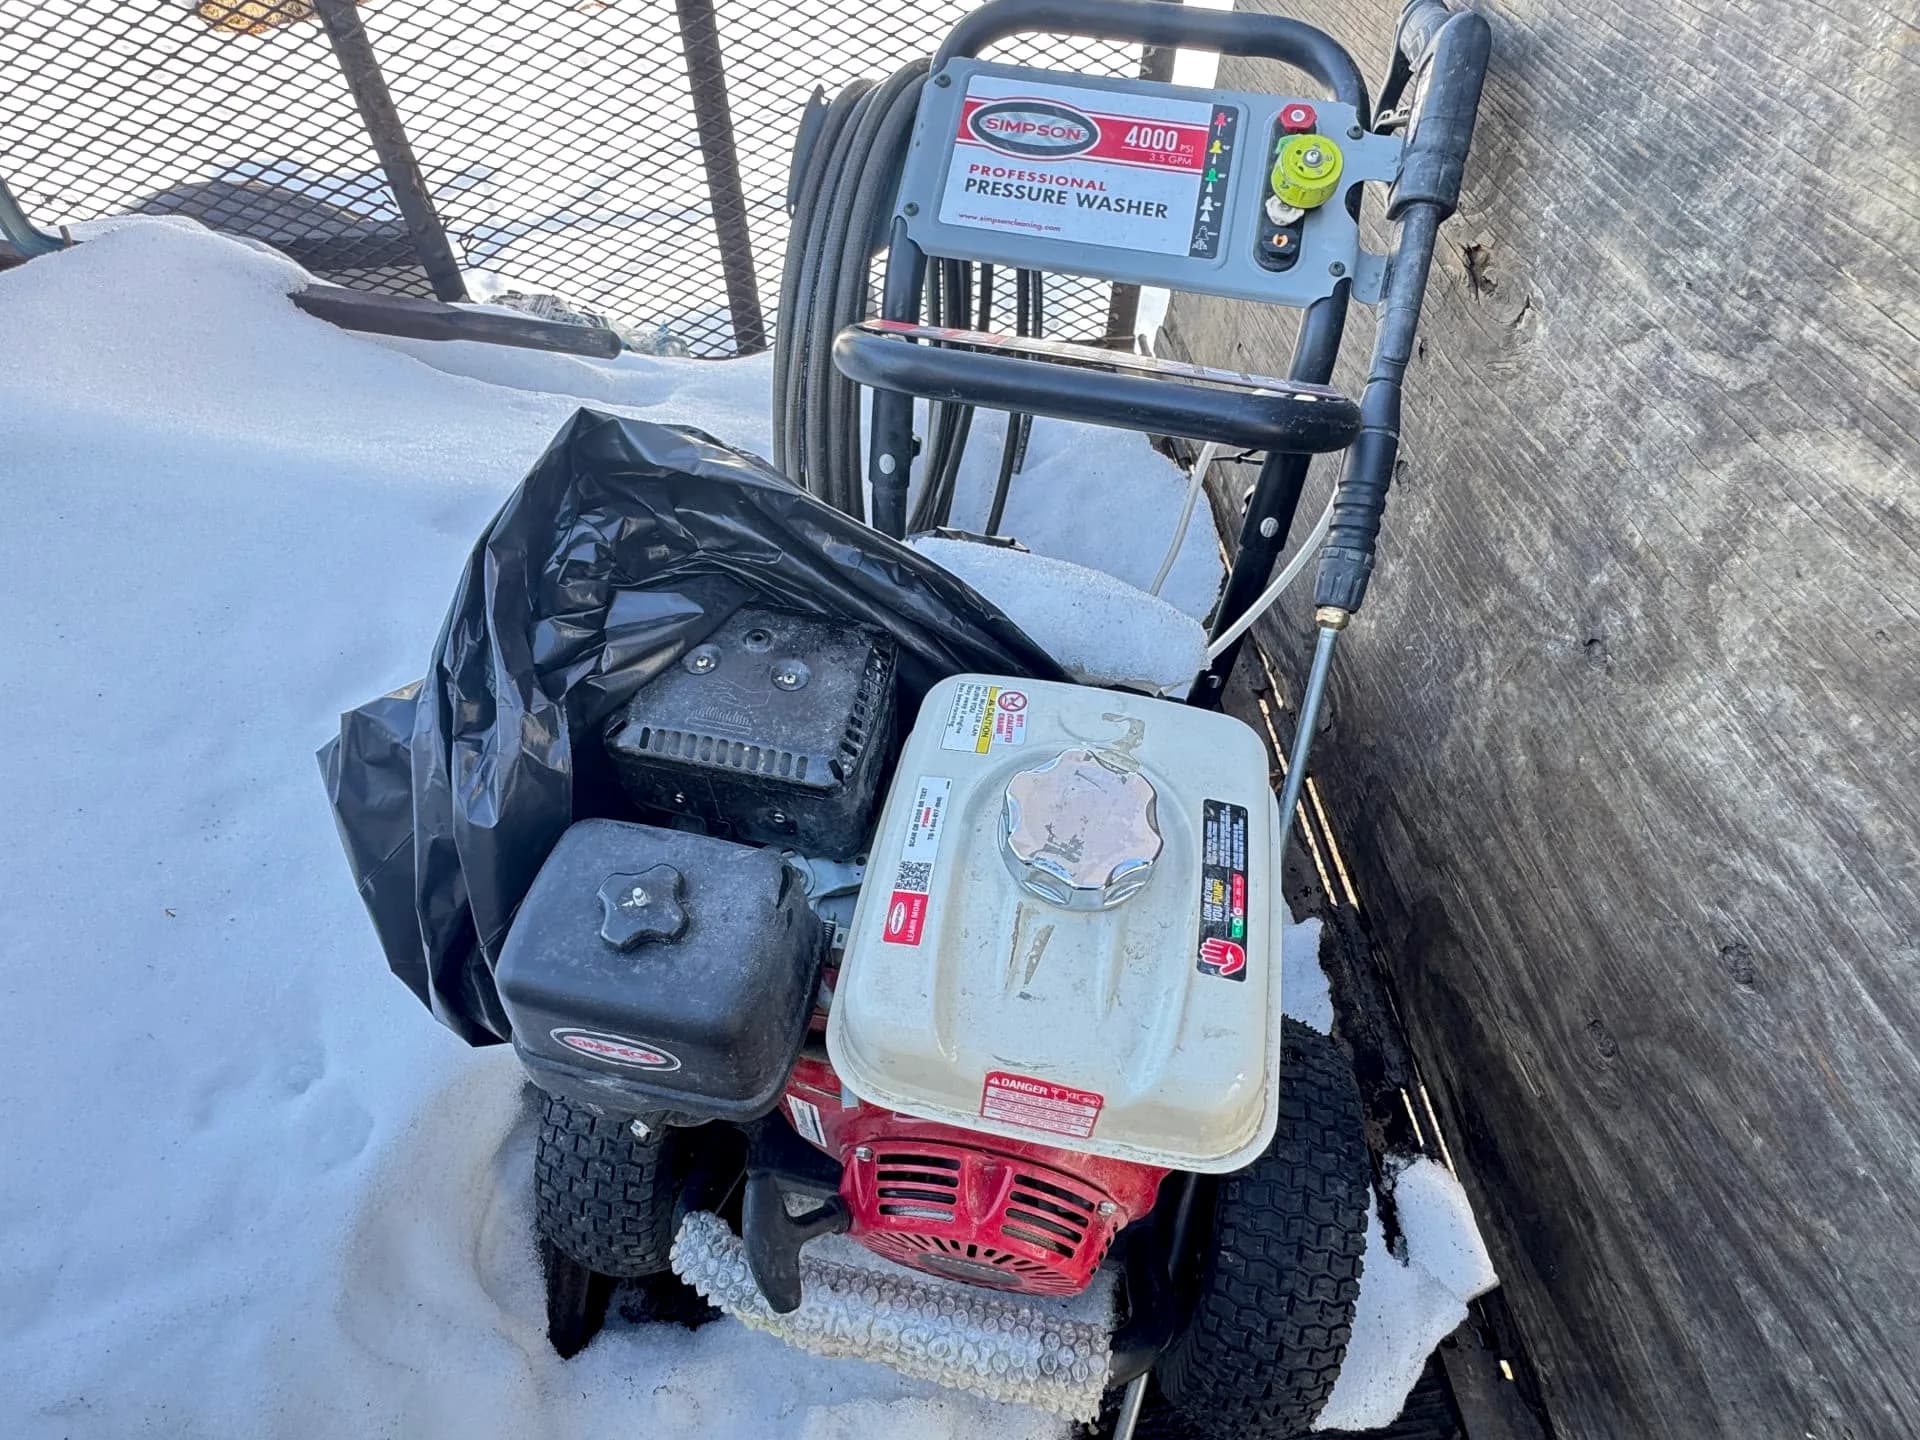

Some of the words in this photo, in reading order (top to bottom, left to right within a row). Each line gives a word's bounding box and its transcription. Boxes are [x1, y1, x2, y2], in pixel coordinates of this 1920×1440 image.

[985, 117, 1081, 141] SIMPSON
[1124, 125, 1178, 151] 4000
[1180, 144, 1194, 153] PSI
[1168, 155, 1192, 166] GPM
[969, 164, 1107, 191] PROFESSIONAL
[965, 178, 1069, 205] PRESSURE
[1076, 192, 1168, 219] WASHER
[981, 707, 995, 738] CAUTION
[908, 832, 917, 847] SCAN
[919, 787, 928, 800] TEXT
[1204, 876, 1213, 902] BEFORE
[1212, 879, 1224, 905] PUMP!
[911, 898, 921, 919] MORE
[1203, 902, 1213, 920] LOOK
[1212, 905, 1223, 921] YOU
[905, 919, 918, 942] LEARN
[1001, 1078, 1048, 1096] DANGER
